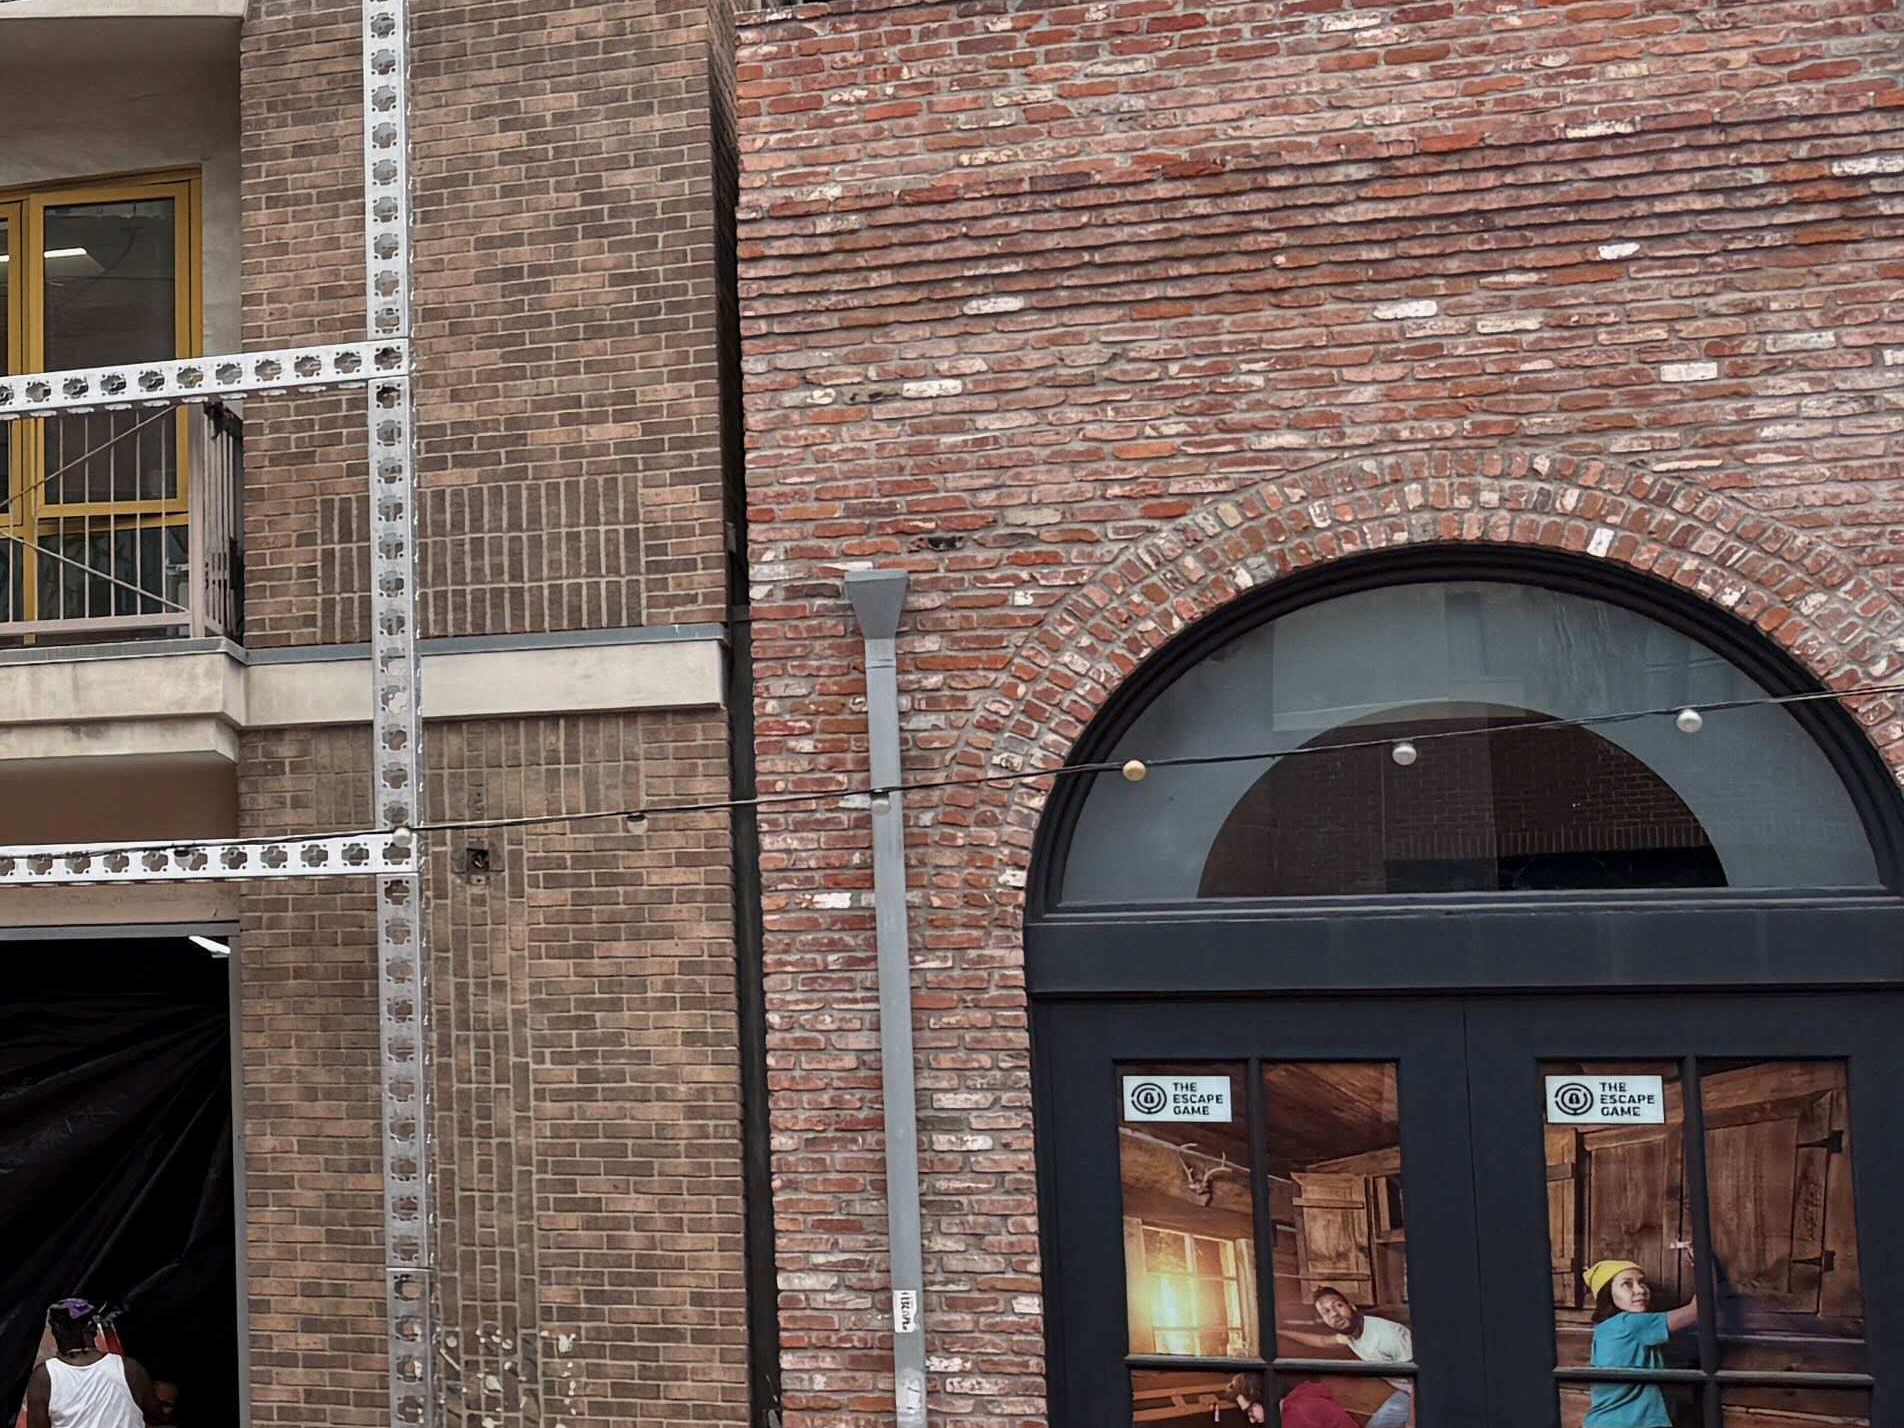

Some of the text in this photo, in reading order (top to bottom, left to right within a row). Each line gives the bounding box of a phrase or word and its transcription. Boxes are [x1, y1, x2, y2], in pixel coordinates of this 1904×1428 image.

[1173, 1082, 1198, 1092] THE
[1599, 1082, 1627, 1092] THE
[1173, 1094, 1224, 1104] ESCAPE
[1600, 1094, 1656, 1105] ESCAPE
[1173, 1106, 1210, 1116] GAME
[1600, 1106, 1641, 1117] GAME
